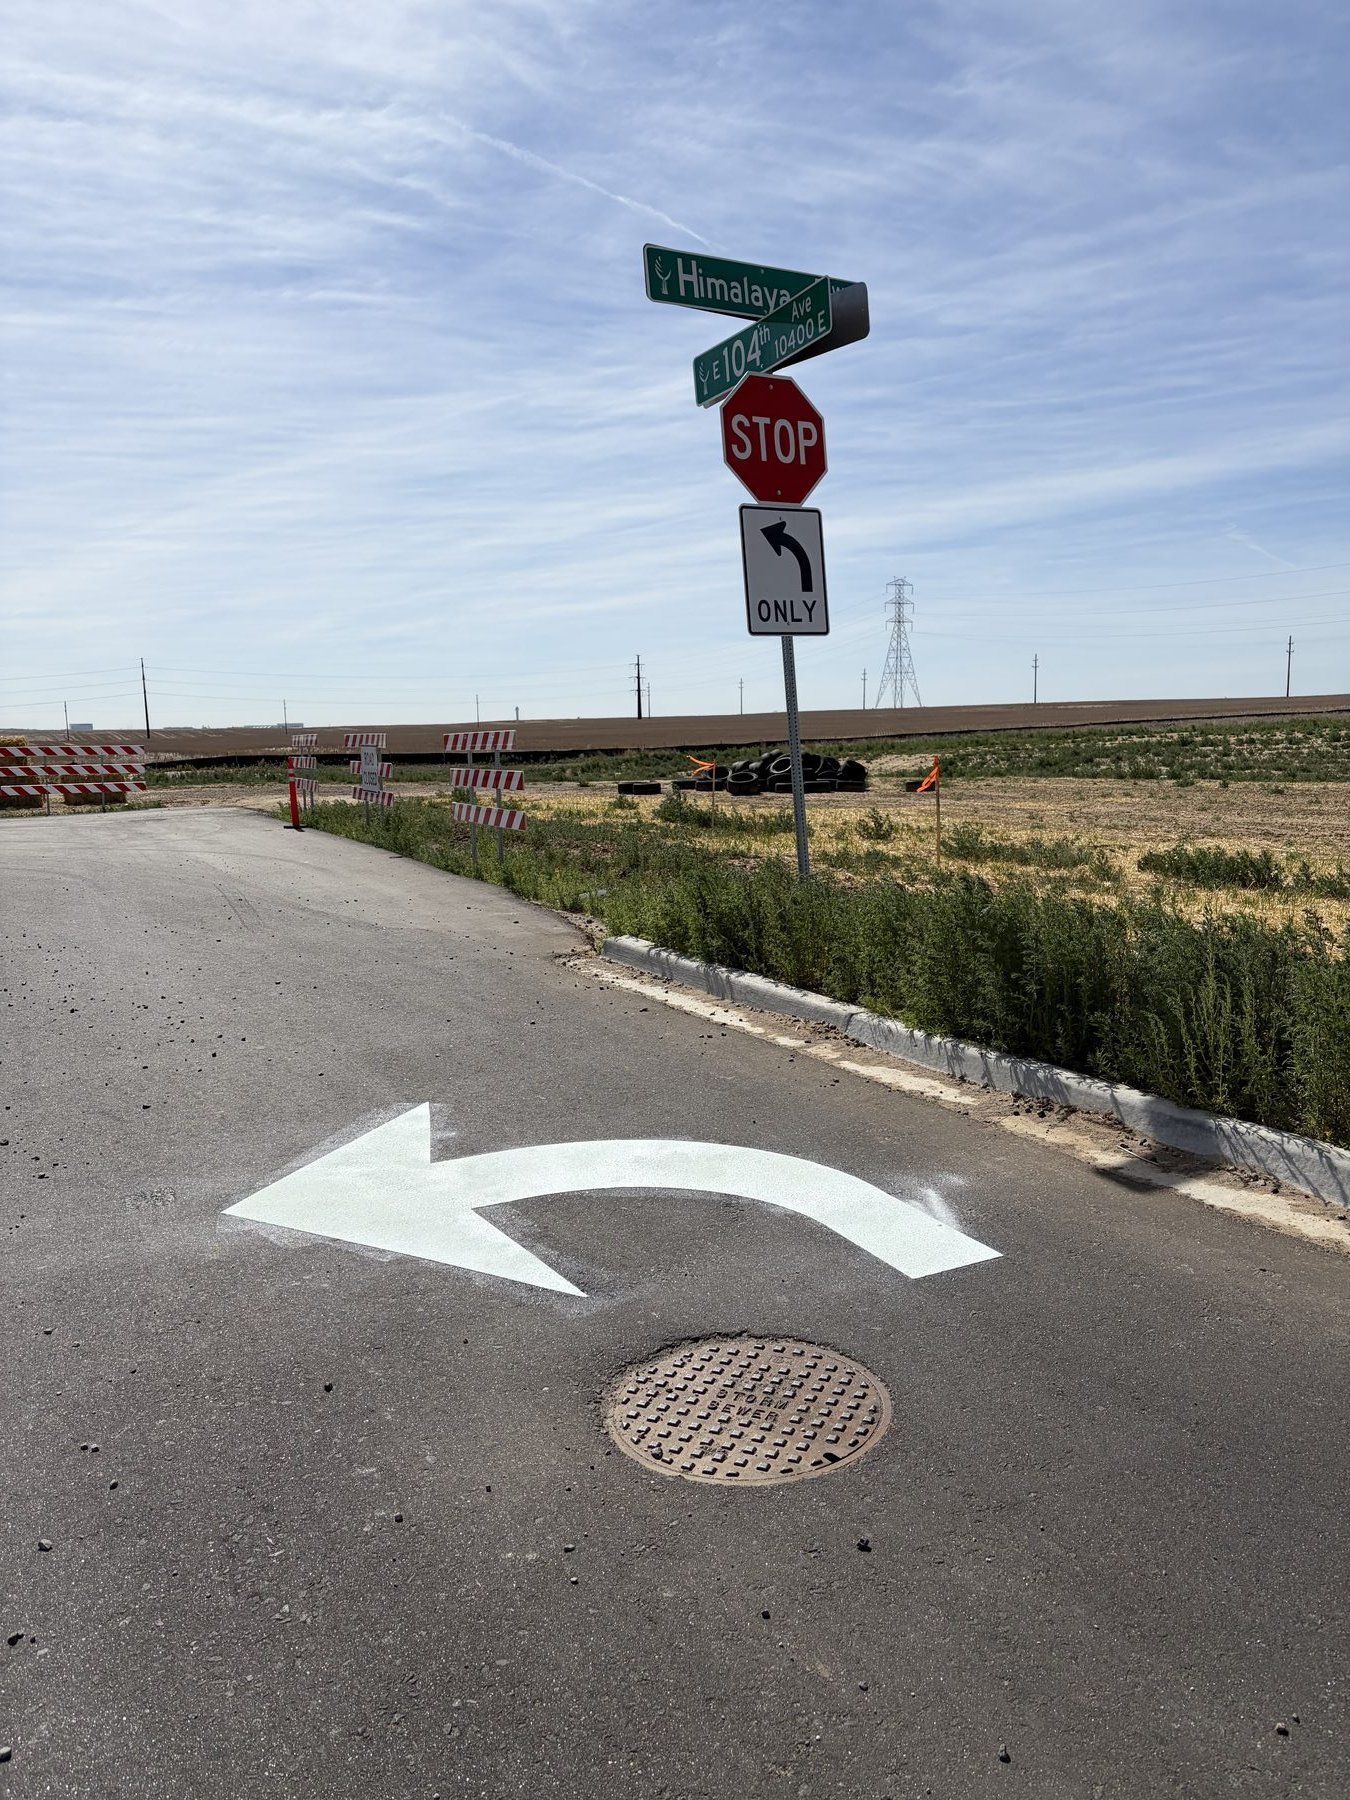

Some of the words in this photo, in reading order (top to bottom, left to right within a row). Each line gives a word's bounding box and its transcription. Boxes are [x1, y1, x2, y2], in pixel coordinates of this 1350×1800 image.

[677, 257, 792, 312] Himalaya
[791, 296, 812, 322] Ave
[713, 360, 720, 380] E
[722, 324, 771, 382] 104th
[774, 317, 814, 359] 10400
[818, 310, 826, 333] E
[731, 413, 818, 465] STOP
[758, 600, 817, 623] ONLY
[707, 1400, 778, 1421] SEWER
[717, 1389, 789, 1410] STORM
